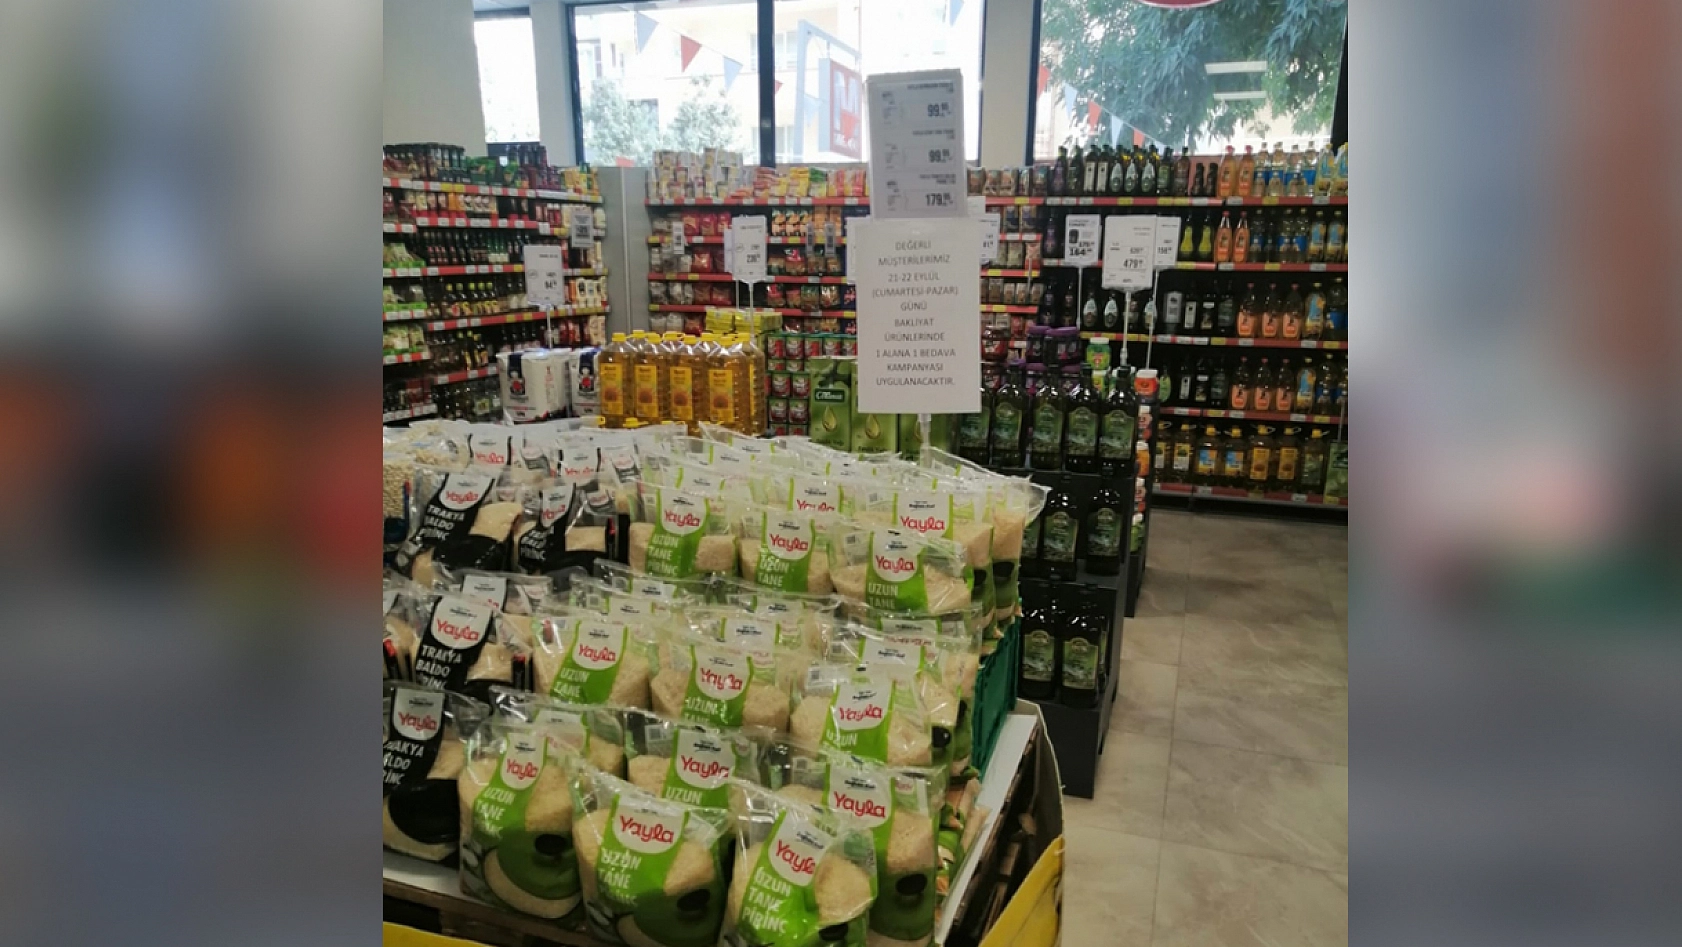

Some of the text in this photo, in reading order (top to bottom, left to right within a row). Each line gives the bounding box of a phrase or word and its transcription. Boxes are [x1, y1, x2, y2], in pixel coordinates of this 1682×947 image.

[888, 271, 940, 283] 21-22 EYLÜL
[900, 300, 927, 311] GÜNÜ
[876, 348, 956, 358] 1 ALANA 1 BEDAVA
[887, 362, 944, 372] KAMPANYASI
[663, 510, 701, 527] Yayla
[900, 515, 945, 534] Yayla
[769, 533, 809, 552] Yayla
[875, 554, 915, 574] Yayla
[868, 582, 899, 597] UZUN
[437, 618, 480, 642] Yayla
[578, 642, 617, 663] Yayla
[397, 711, 437, 732] Yayla
[506, 758, 538, 780] Yayla
[681, 754, 730, 779] Yayla
[665, 786, 703, 806] UZUN
[833, 790, 886, 819] Yayla
[619, 814, 674, 844] Yayla
[754, 866, 793, 898] UZUN
[741, 904, 788, 937] PİRİNÇ
